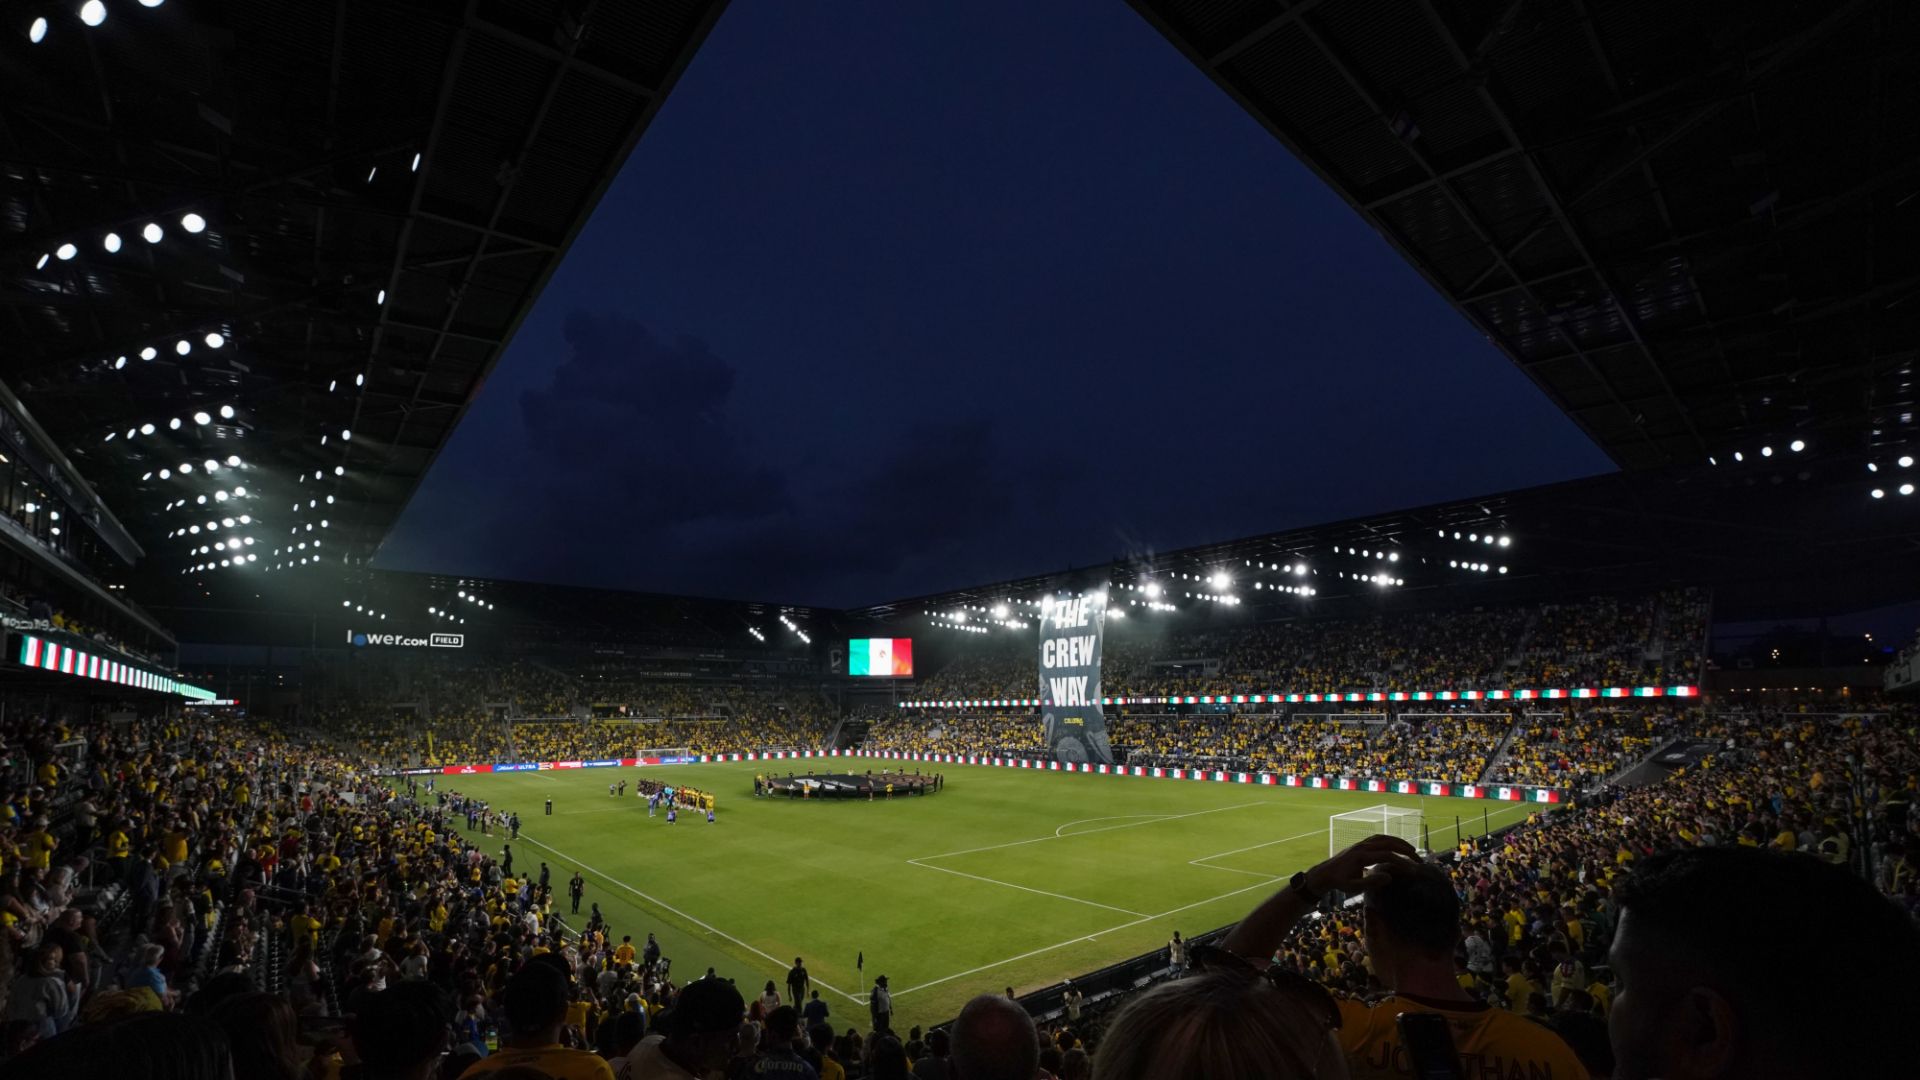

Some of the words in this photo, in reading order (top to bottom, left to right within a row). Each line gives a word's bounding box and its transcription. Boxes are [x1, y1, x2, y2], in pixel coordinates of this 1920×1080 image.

[1055, 597, 1089, 629] THE
[435, 636, 459, 645] FIELD
[1043, 635, 1096, 669] CREW
